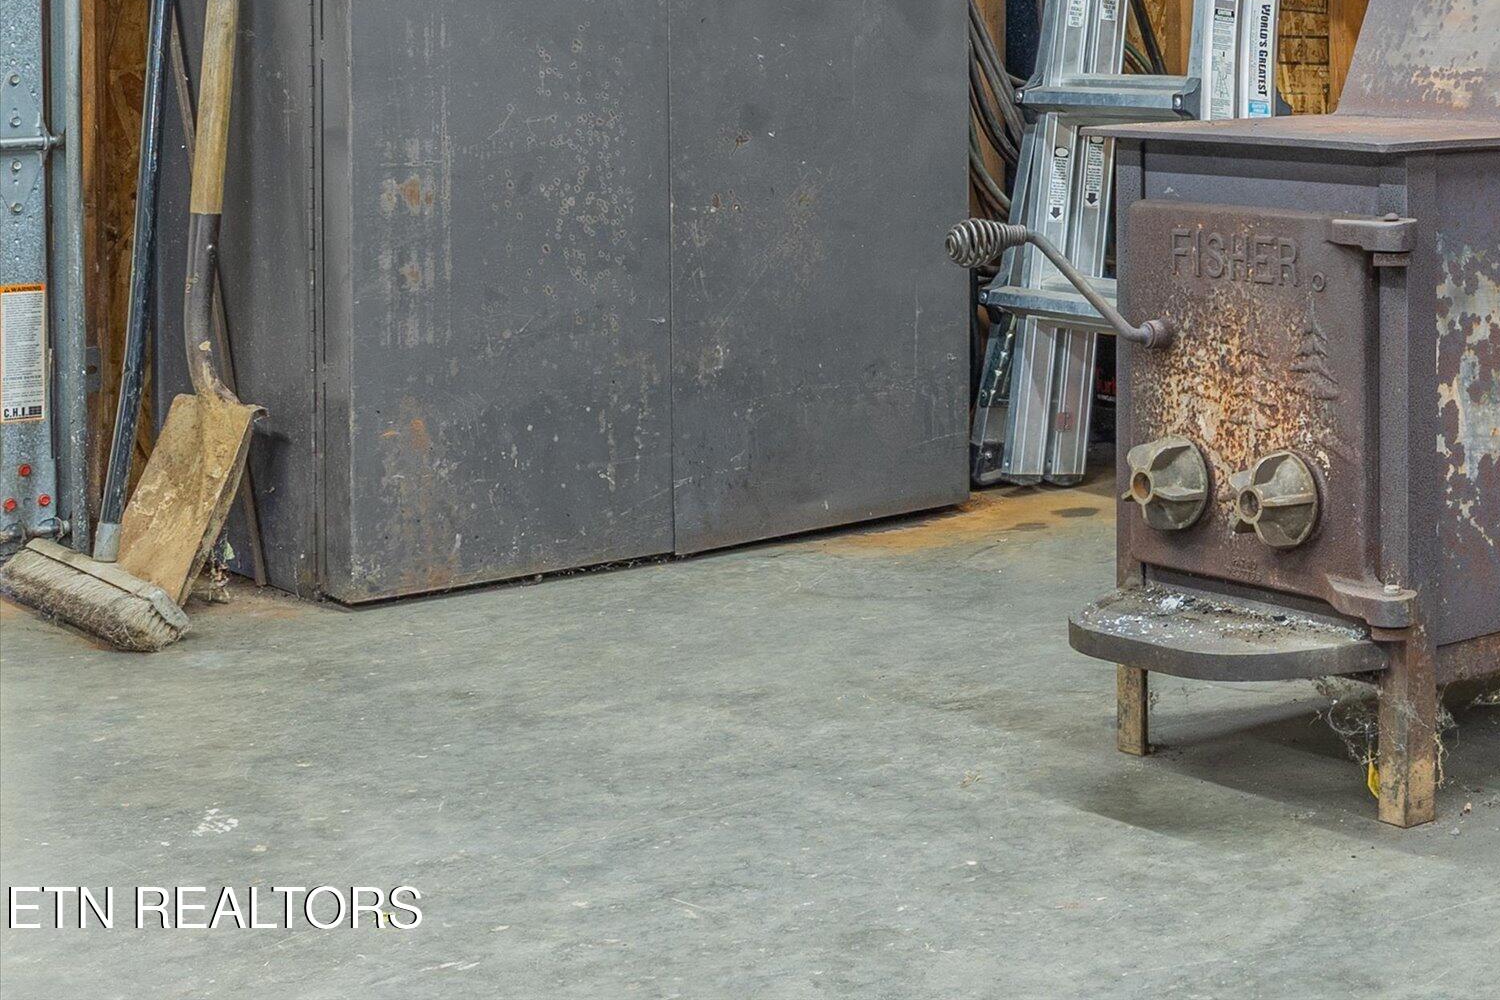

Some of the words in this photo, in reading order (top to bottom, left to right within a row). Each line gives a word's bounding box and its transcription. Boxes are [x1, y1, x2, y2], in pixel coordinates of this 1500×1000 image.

[1258, 4, 1271, 49] WORLD'S
[1257, 49, 1269, 97] GREATEST
[1169, 227, 1300, 288] FISHER
